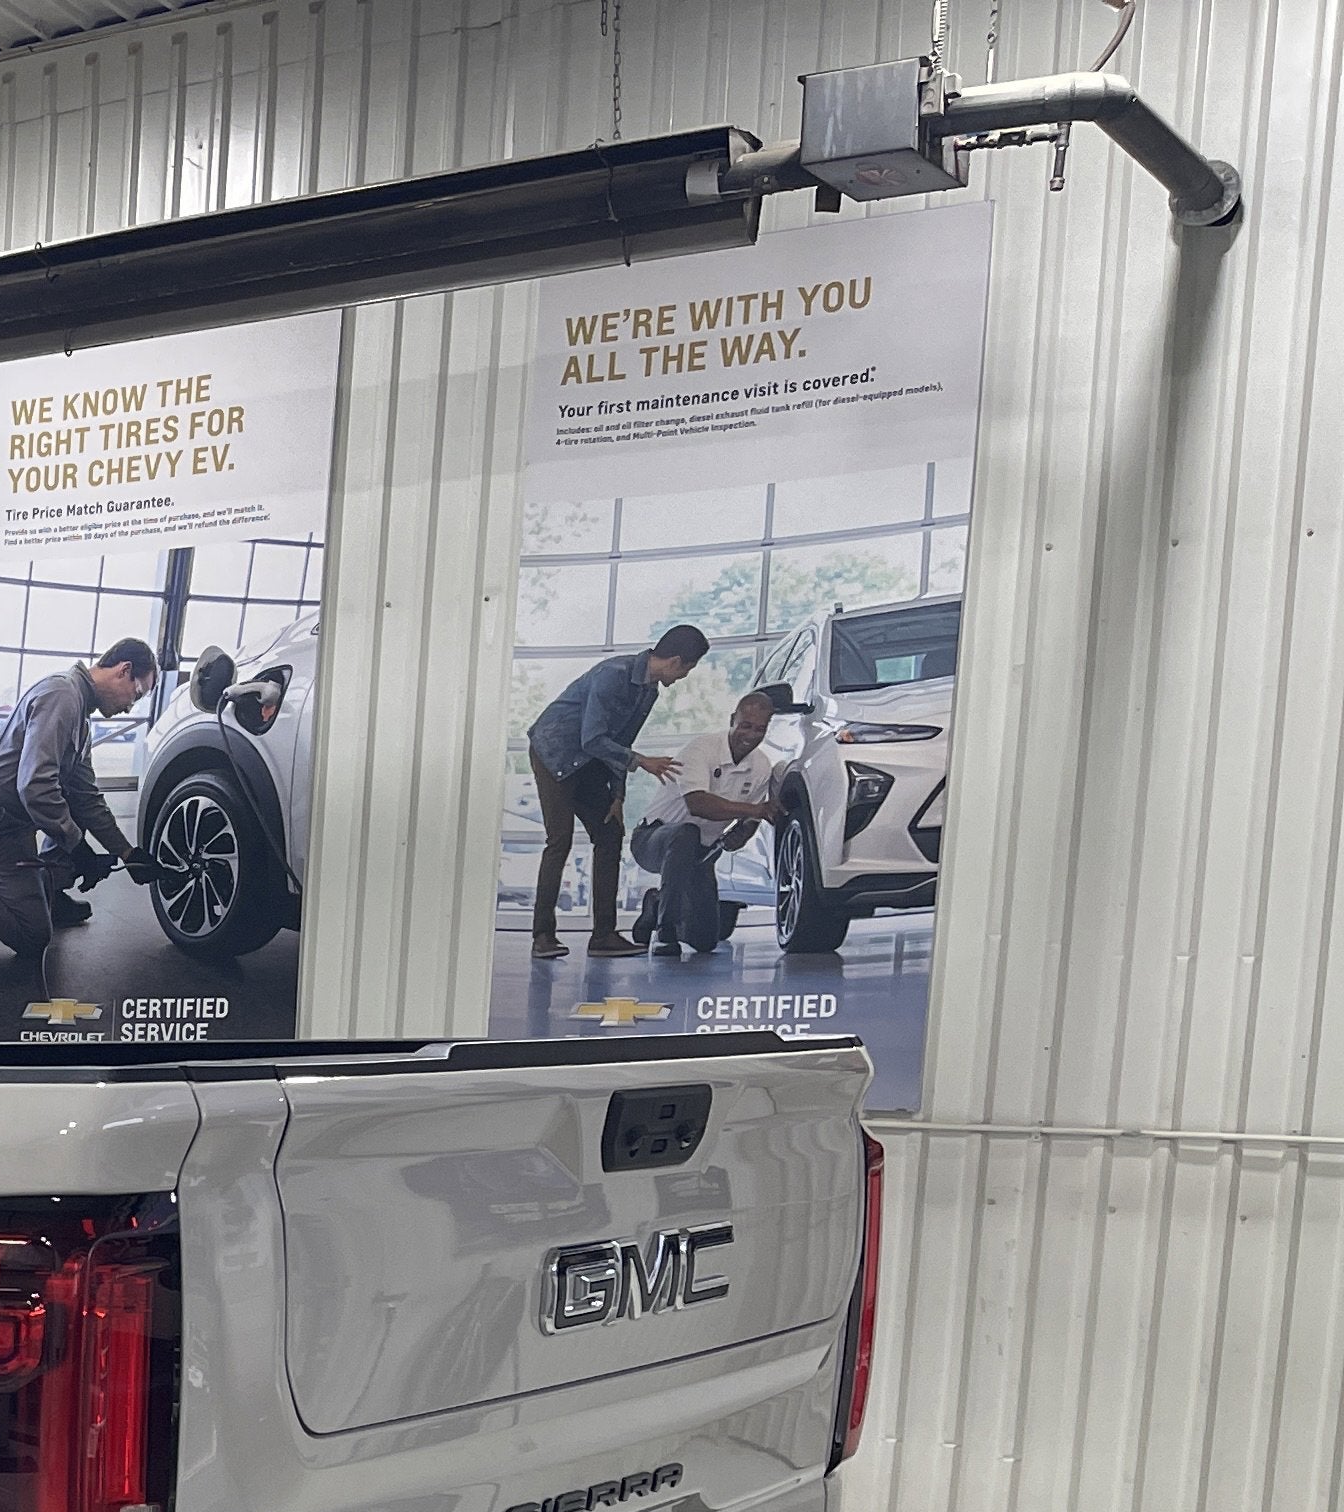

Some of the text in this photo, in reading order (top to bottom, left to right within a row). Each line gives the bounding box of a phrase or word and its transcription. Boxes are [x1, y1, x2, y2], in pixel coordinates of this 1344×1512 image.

[566, 277, 872, 346] WE'RE WITH YOU
[560, 328, 807, 386] ALL THE WAY.
[11, 374, 212, 426] WE KNOW THE
[558, 403, 594, 419] Your
[597, 398, 632, 415] first
[635, 388, 740, 413] maintenance
[743, 381, 779, 399] visit
[783, 379, 798, 394] is
[605, 423, 621, 432] and
[621, 421, 632, 431] oil
[633, 419, 654, 429] filter
[689, 412, 713, 423] diesel
[715, 408, 749, 420] exhaust
[750, 404, 770, 416] fluid
[771, 403, 791, 413] tank
[792, 400, 813, 411] refill
[814, 398, 831, 410] (for
[833, 387, 904, 406] diesel-equipped
[10, 406, 245, 460] RIGHT TIRES FOR
[616, 432, 631, 442] and
[680, 425, 710, 437] Vehicle
[8, 444, 235, 493] YOUR CHEVY EV.
[5, 497, 175, 521] Tire Price Match Guarantee.
[58, 525, 79, 533] better
[104, 520, 121, 530] price
[202, 509, 216, 518] and
[233, 505, 256, 515] match
[23, 536, 43, 545] better
[44, 535, 62, 545] price
[93, 531, 109, 541] days
[163, 524, 177, 533] and
[194, 520, 218, 530] refund
[121, 997, 229, 1019] CERTIFIED
[697, 994, 837, 1019] CERTIFIED
[20, 1031, 105, 1043] CHEVROLET
[120, 1022, 209, 1042] SERVICE
[538, 1220, 735, 1337] GMC
